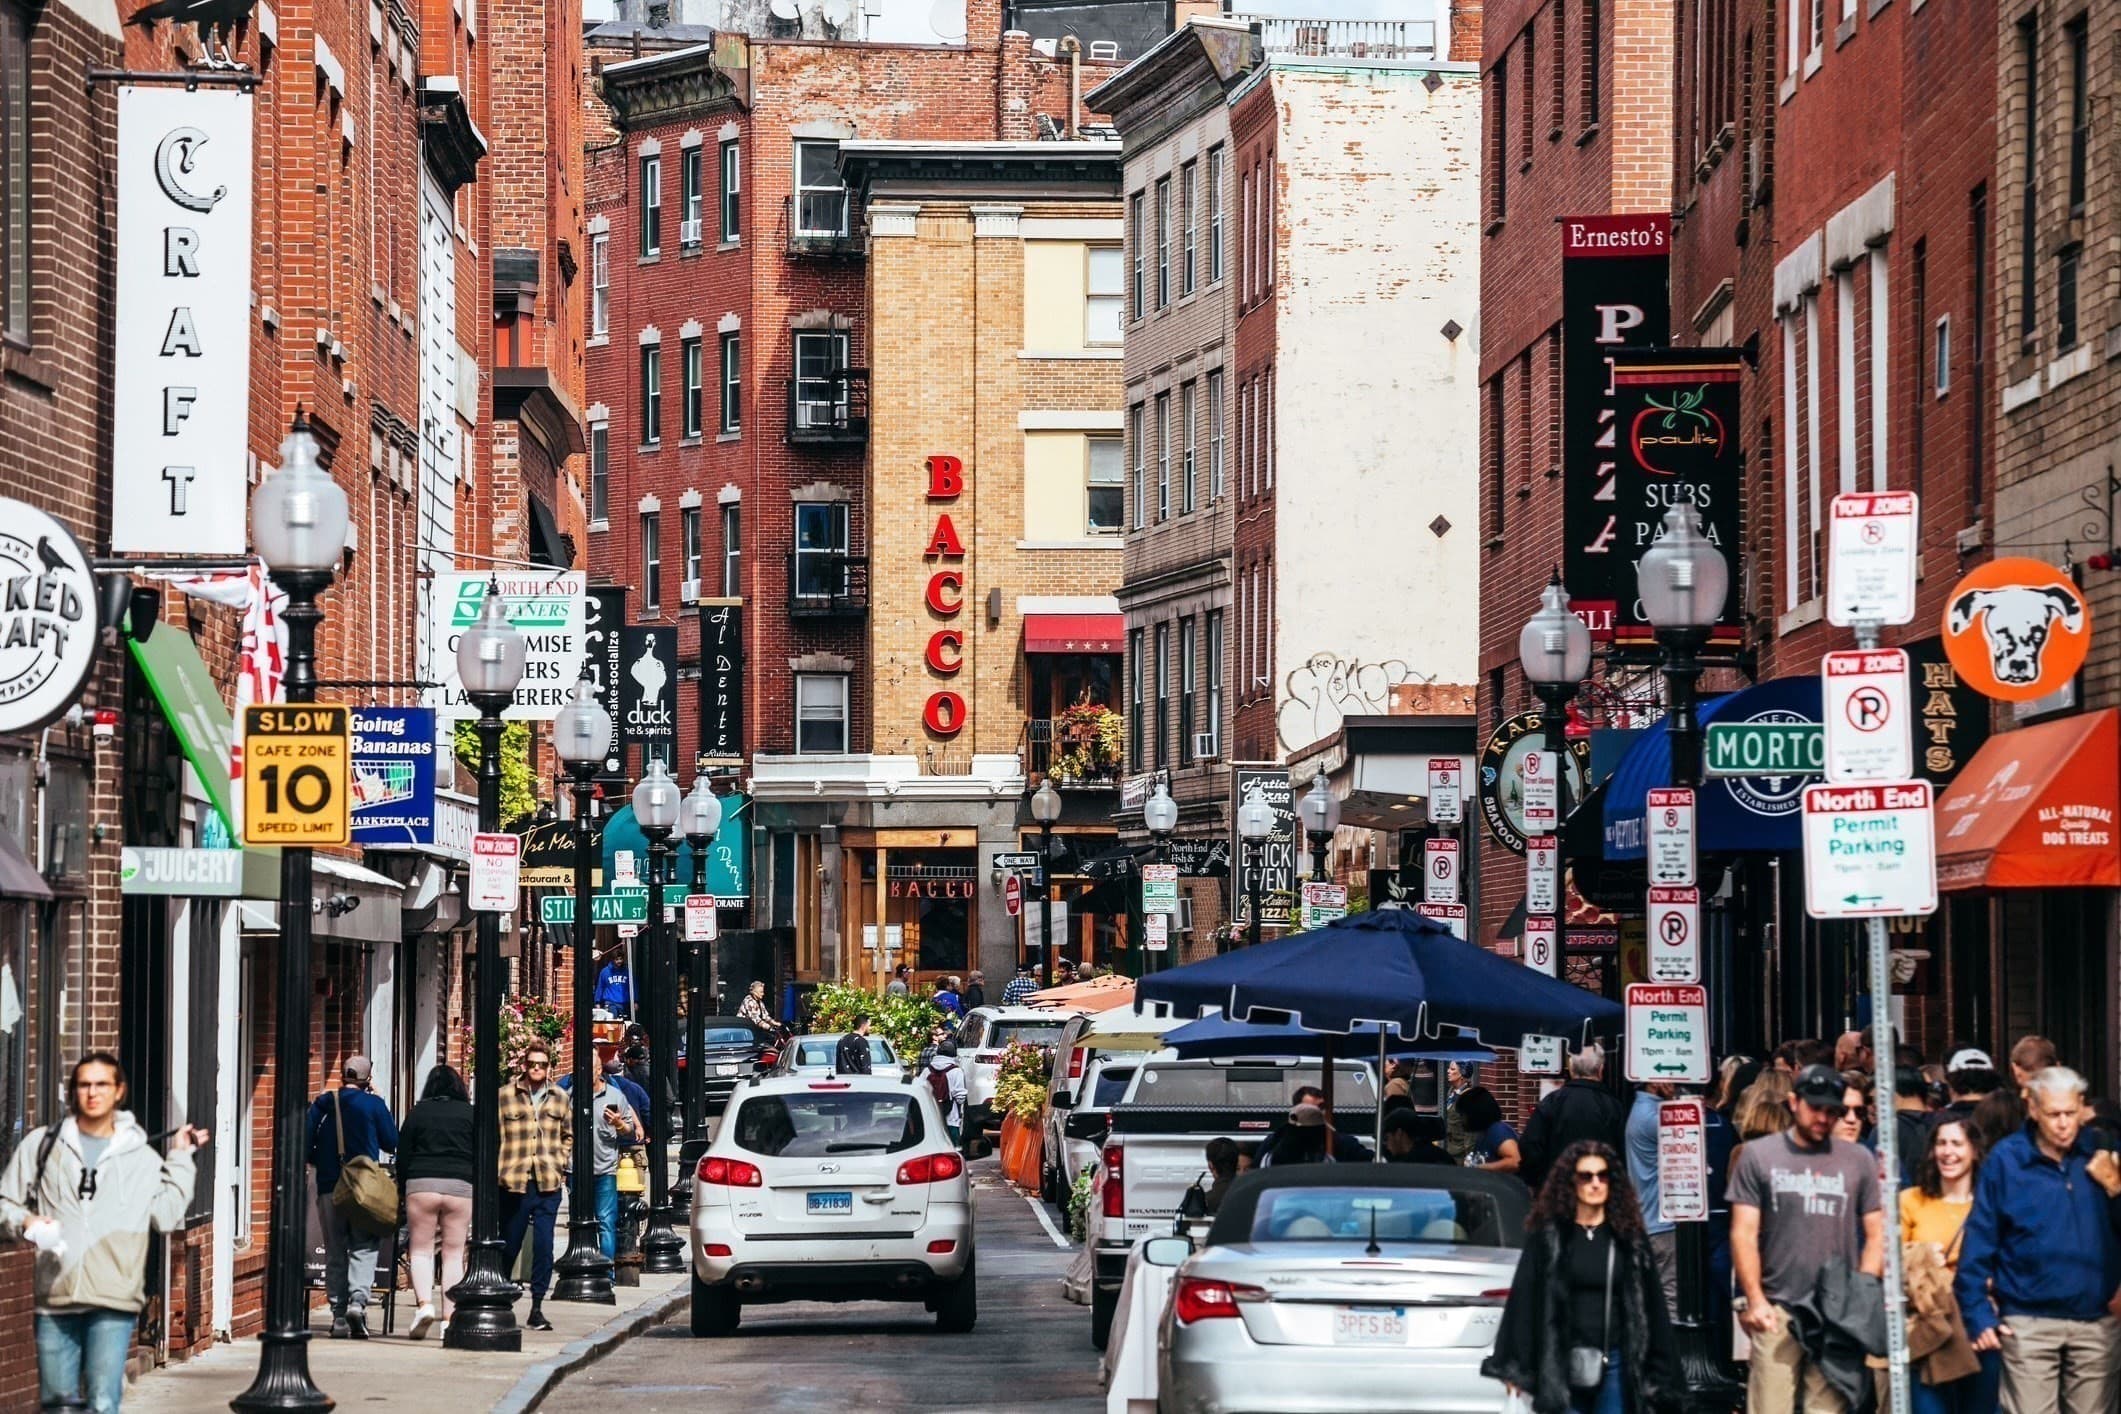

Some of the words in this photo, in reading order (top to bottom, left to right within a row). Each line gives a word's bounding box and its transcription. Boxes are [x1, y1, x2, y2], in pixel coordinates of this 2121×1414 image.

[1570, 223, 1663, 247] Ernesto's
[155, 127, 228, 515] CRAFT
[545, 580, 578, 595] END
[924, 456, 966, 734] BACCO
[0, 575, 83, 622] KED
[0, 616, 70, 660] AFT
[1830, 657, 1860, 673] TOW
[1864, 654, 1904, 671] ZONE
[716, 655, 731, 745] Dente
[627, 700, 671, 724] duck
[1922, 663, 1957, 772] HATS
[258, 712, 334, 732] SLOW
[350, 714, 405, 735] Going
[256, 745, 292, 756] CAFE
[298, 745, 337, 757] ZONE
[350, 736, 432, 754] Bananas
[1717, 732, 1824, 766] MORTO
[260, 765, 331, 814] 10
[1651, 793, 1667, 804] TOW
[1670, 792, 1691, 804] ZONE
[1736, 788, 1796, 811] ESTABLISHED
[1812, 791, 1876, 811] North
[1883, 787, 1925, 808] End
[2038, 805, 2112, 823] ALL-NATURAL
[258, 822, 297, 833] SPEED
[303, 822, 332, 832] LIMIT
[1484, 796, 1524, 851] SEAFOOD
[1833, 817, 1897, 832] Permit
[476, 839, 494, 853] TOW
[495, 840, 515, 854] ZONE
[1172, 843, 1193, 852] North
[1194, 841, 1208, 852] End
[1830, 840, 1905, 855] Parking
[2042, 832, 2066, 845] DOG
[2069, 832, 2109, 845] TREATS
[487, 858, 502, 866] NO
[1172, 853, 1187, 863] Fish
[1187, 854, 1195, 862] &
[145, 852, 236, 883] JUICERY
[519, 873, 561, 883] estaurant
[563, 873, 572, 883] &
[1651, 890, 1670, 901] TOW
[1671, 890, 1696, 901] ZONE
[545, 900, 623, 919] STILMAN
[632, 908, 641, 917] ST
[1260, 908, 1289, 918] IZZA
[1420, 906, 1443, 916] North
[1447, 908, 1464, 917] End
[1633, 989, 1674, 1003] North
[1679, 990, 1701, 1003] End
[1651, 1011, 1687, 1022] Permit
[1648, 1028, 1691, 1042] Parking
[1338, 1315, 1378, 1334] 3PFS
